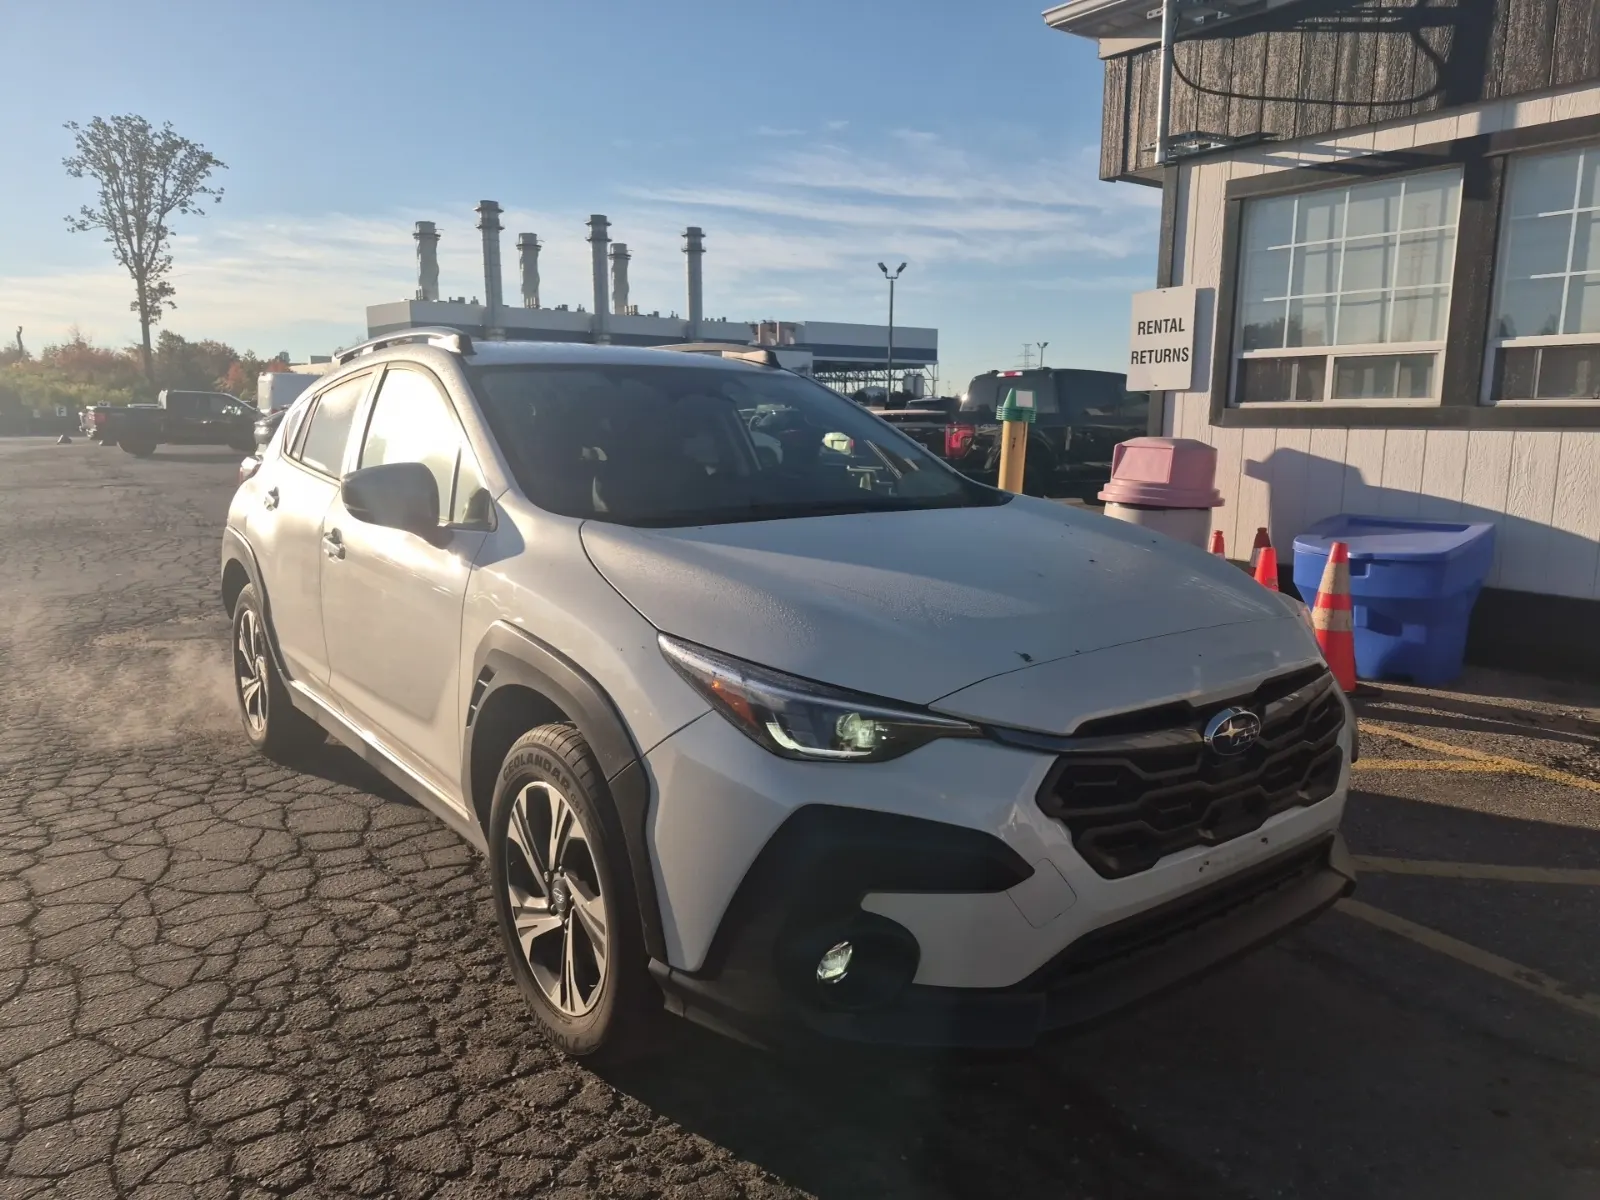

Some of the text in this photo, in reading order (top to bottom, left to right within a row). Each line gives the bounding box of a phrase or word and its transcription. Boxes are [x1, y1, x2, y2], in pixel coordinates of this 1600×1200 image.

[1138, 317, 1185, 335] RENTAL
[1131, 347, 1189, 364] RETURNS
[503, 752, 571, 790] GEOLANDAR
